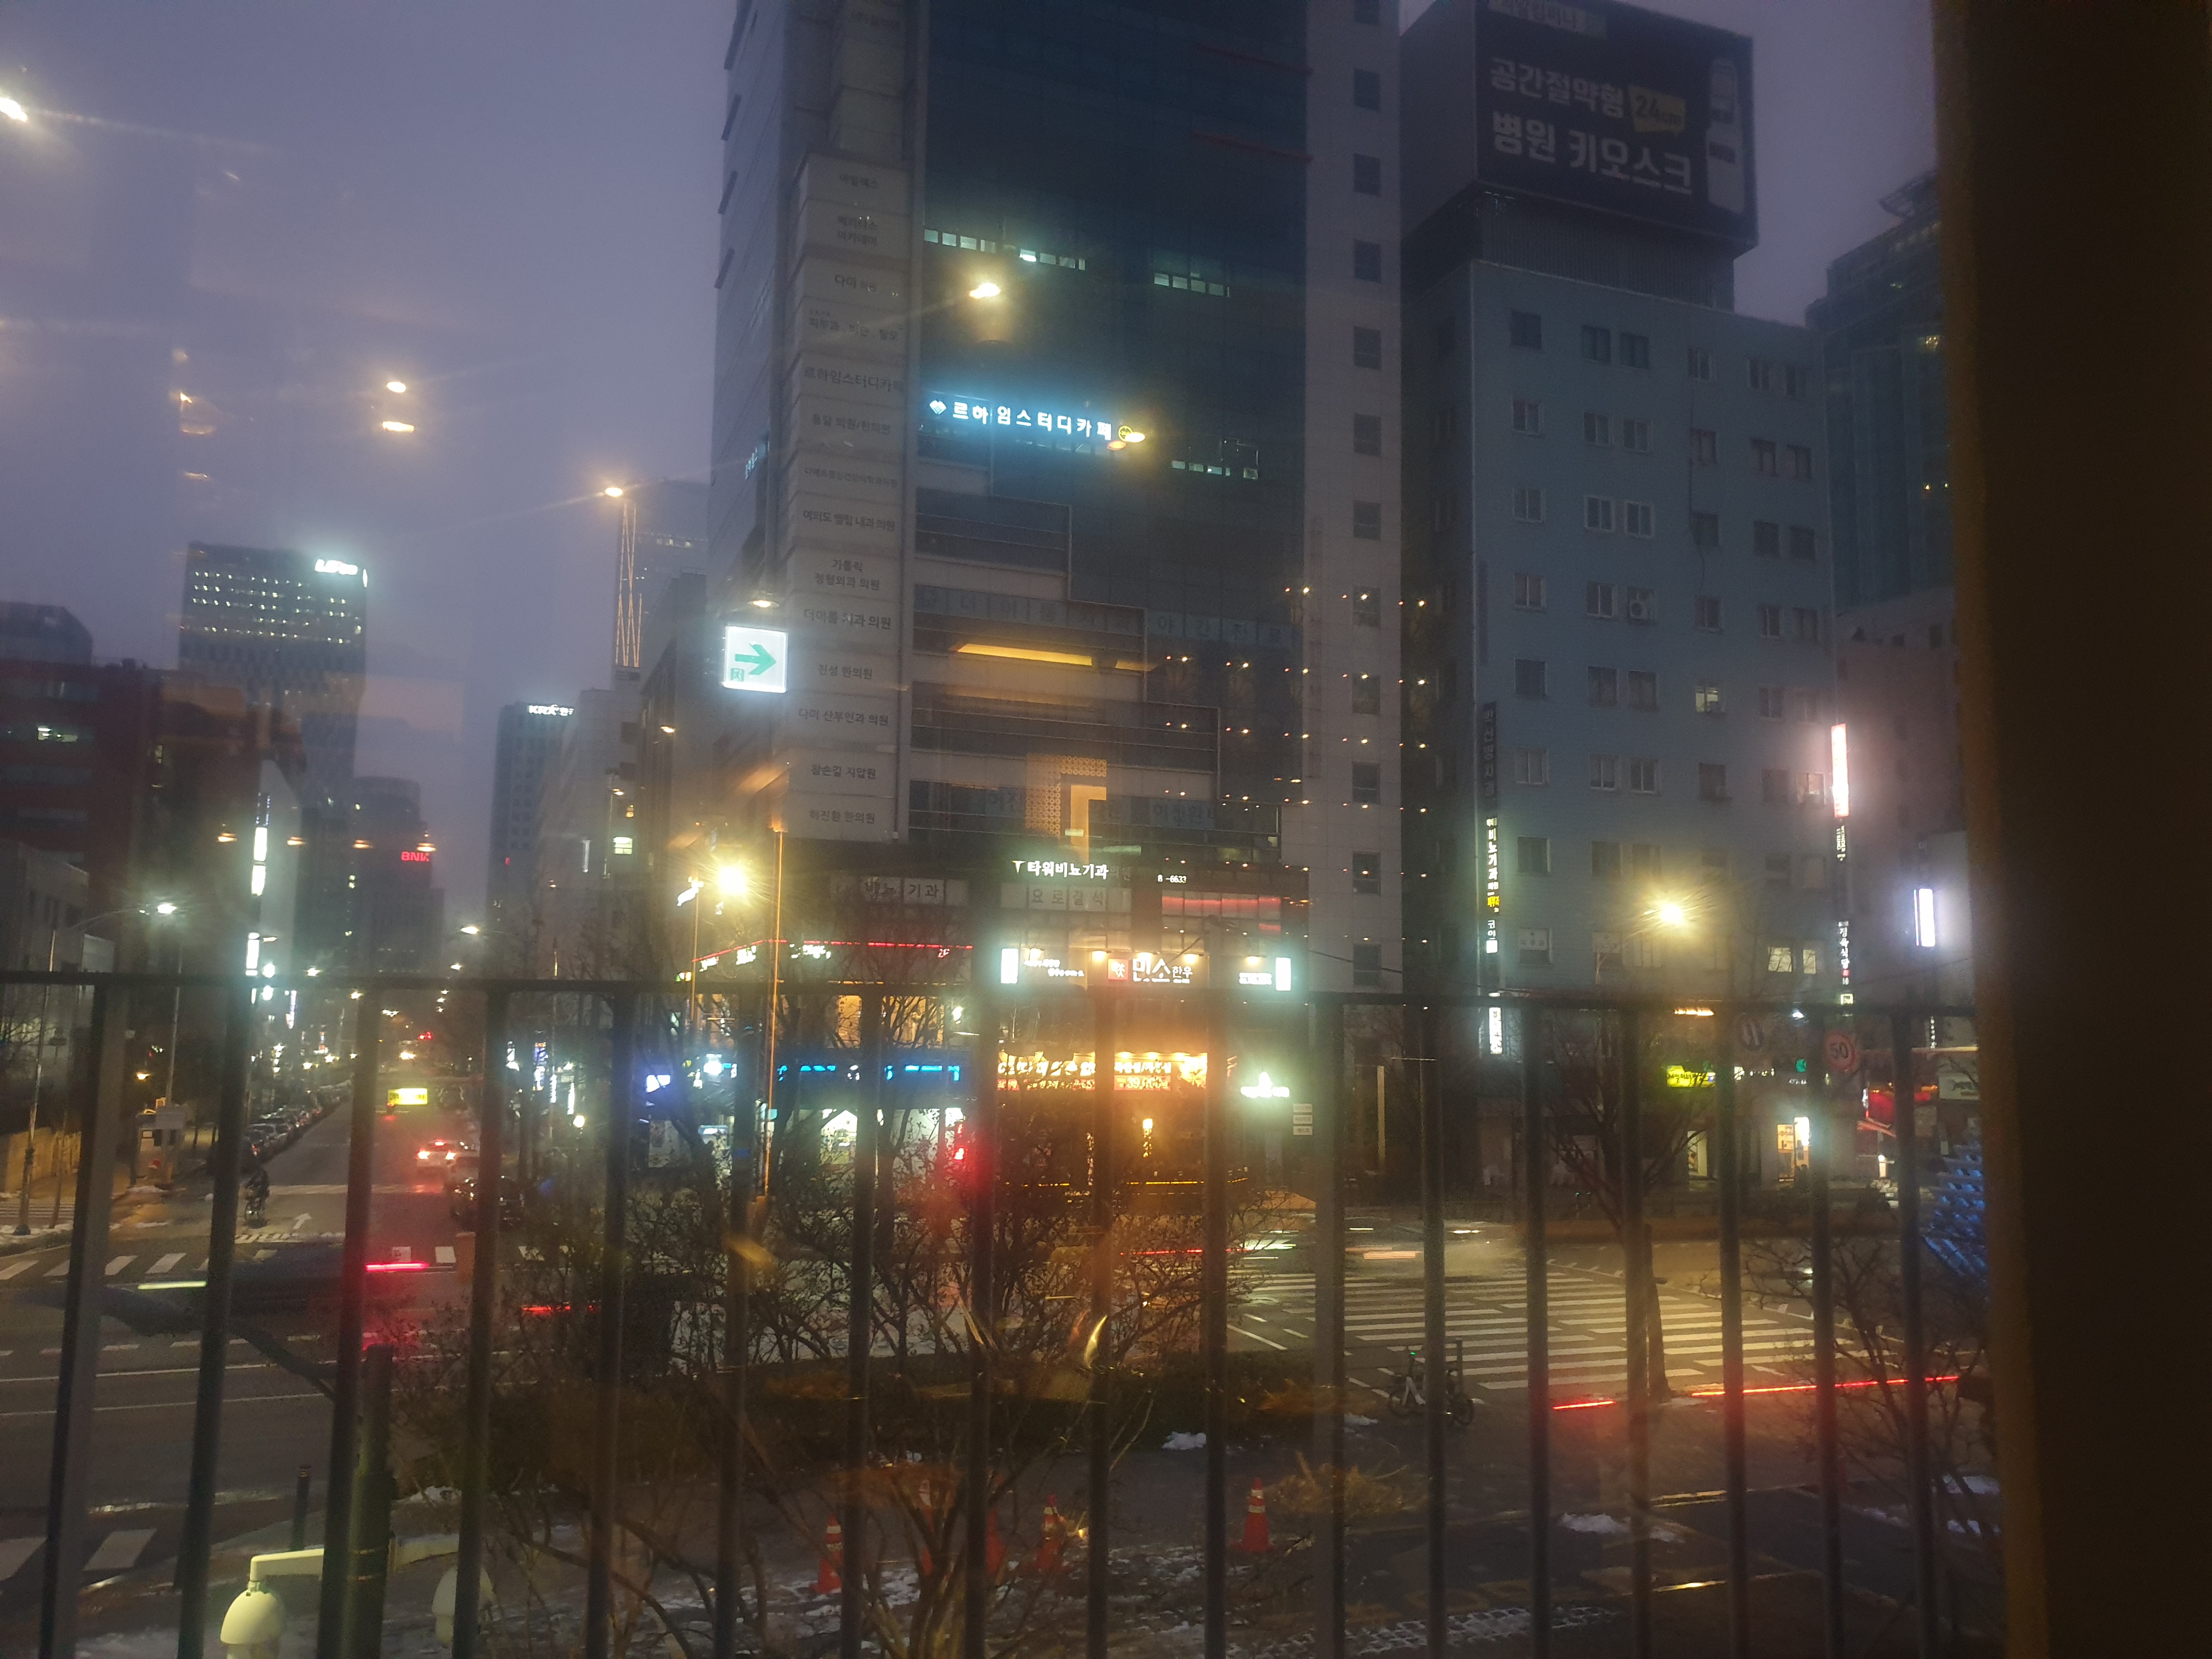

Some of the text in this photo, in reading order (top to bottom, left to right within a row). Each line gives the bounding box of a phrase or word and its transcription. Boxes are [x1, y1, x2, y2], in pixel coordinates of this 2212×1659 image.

[1491, 57, 1624, 119] 공간절약형
[1493, 110, 1693, 196] 병원 키오스크
[952, 401, 1112, 441] 르하임스터디카페
[803, 509, 832, 523] 여의도
[855, 516, 874, 529] 내과
[876, 519, 896, 533] 의원
[814, 573, 881, 591] 정형외과 의원
[868, 615, 892, 630] 의원
[842, 666, 873, 680] 한의원
[528, 705, 557, 715] KRX
[823, 710, 865, 725] 산부인과
[868, 714, 889, 727] 의원
[844, 810, 876, 825] 한의원
[401, 851, 430, 862] BNK
[1027, 860, 1109, 880] 타워비뇨기과
[1031, 889, 1107, 906] 요로결석
[1172, 965, 1193, 979] 한우
